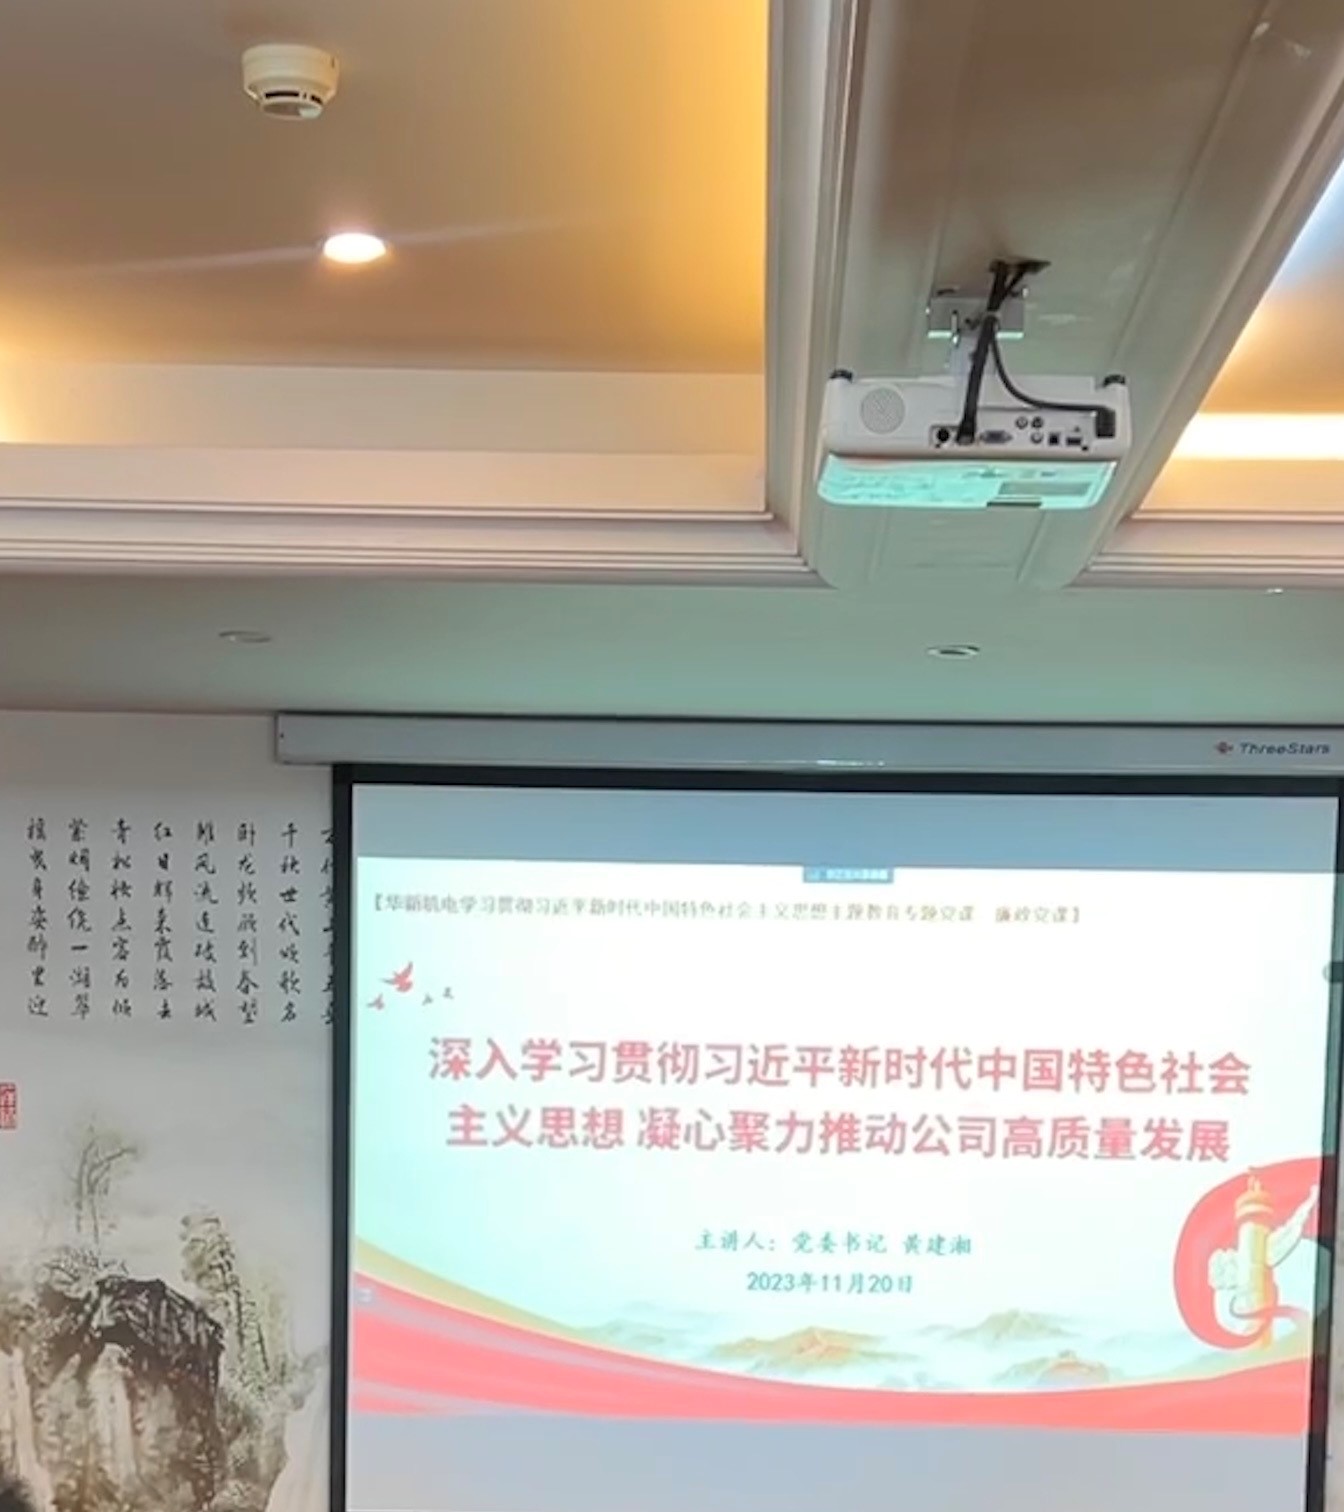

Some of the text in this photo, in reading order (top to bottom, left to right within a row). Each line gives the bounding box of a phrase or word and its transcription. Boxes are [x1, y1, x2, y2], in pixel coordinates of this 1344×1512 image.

[1239, 741, 1332, 755] ThreeStars
[429, 1036, 1250, 1096] 深入学习贯彻习近平新时代中国特色社会
[446, 1103, 1231, 1162] 主义思想 凝心聚力推动公司高质量发展
[746, 1271, 914, 1294] 2023年11月20日
